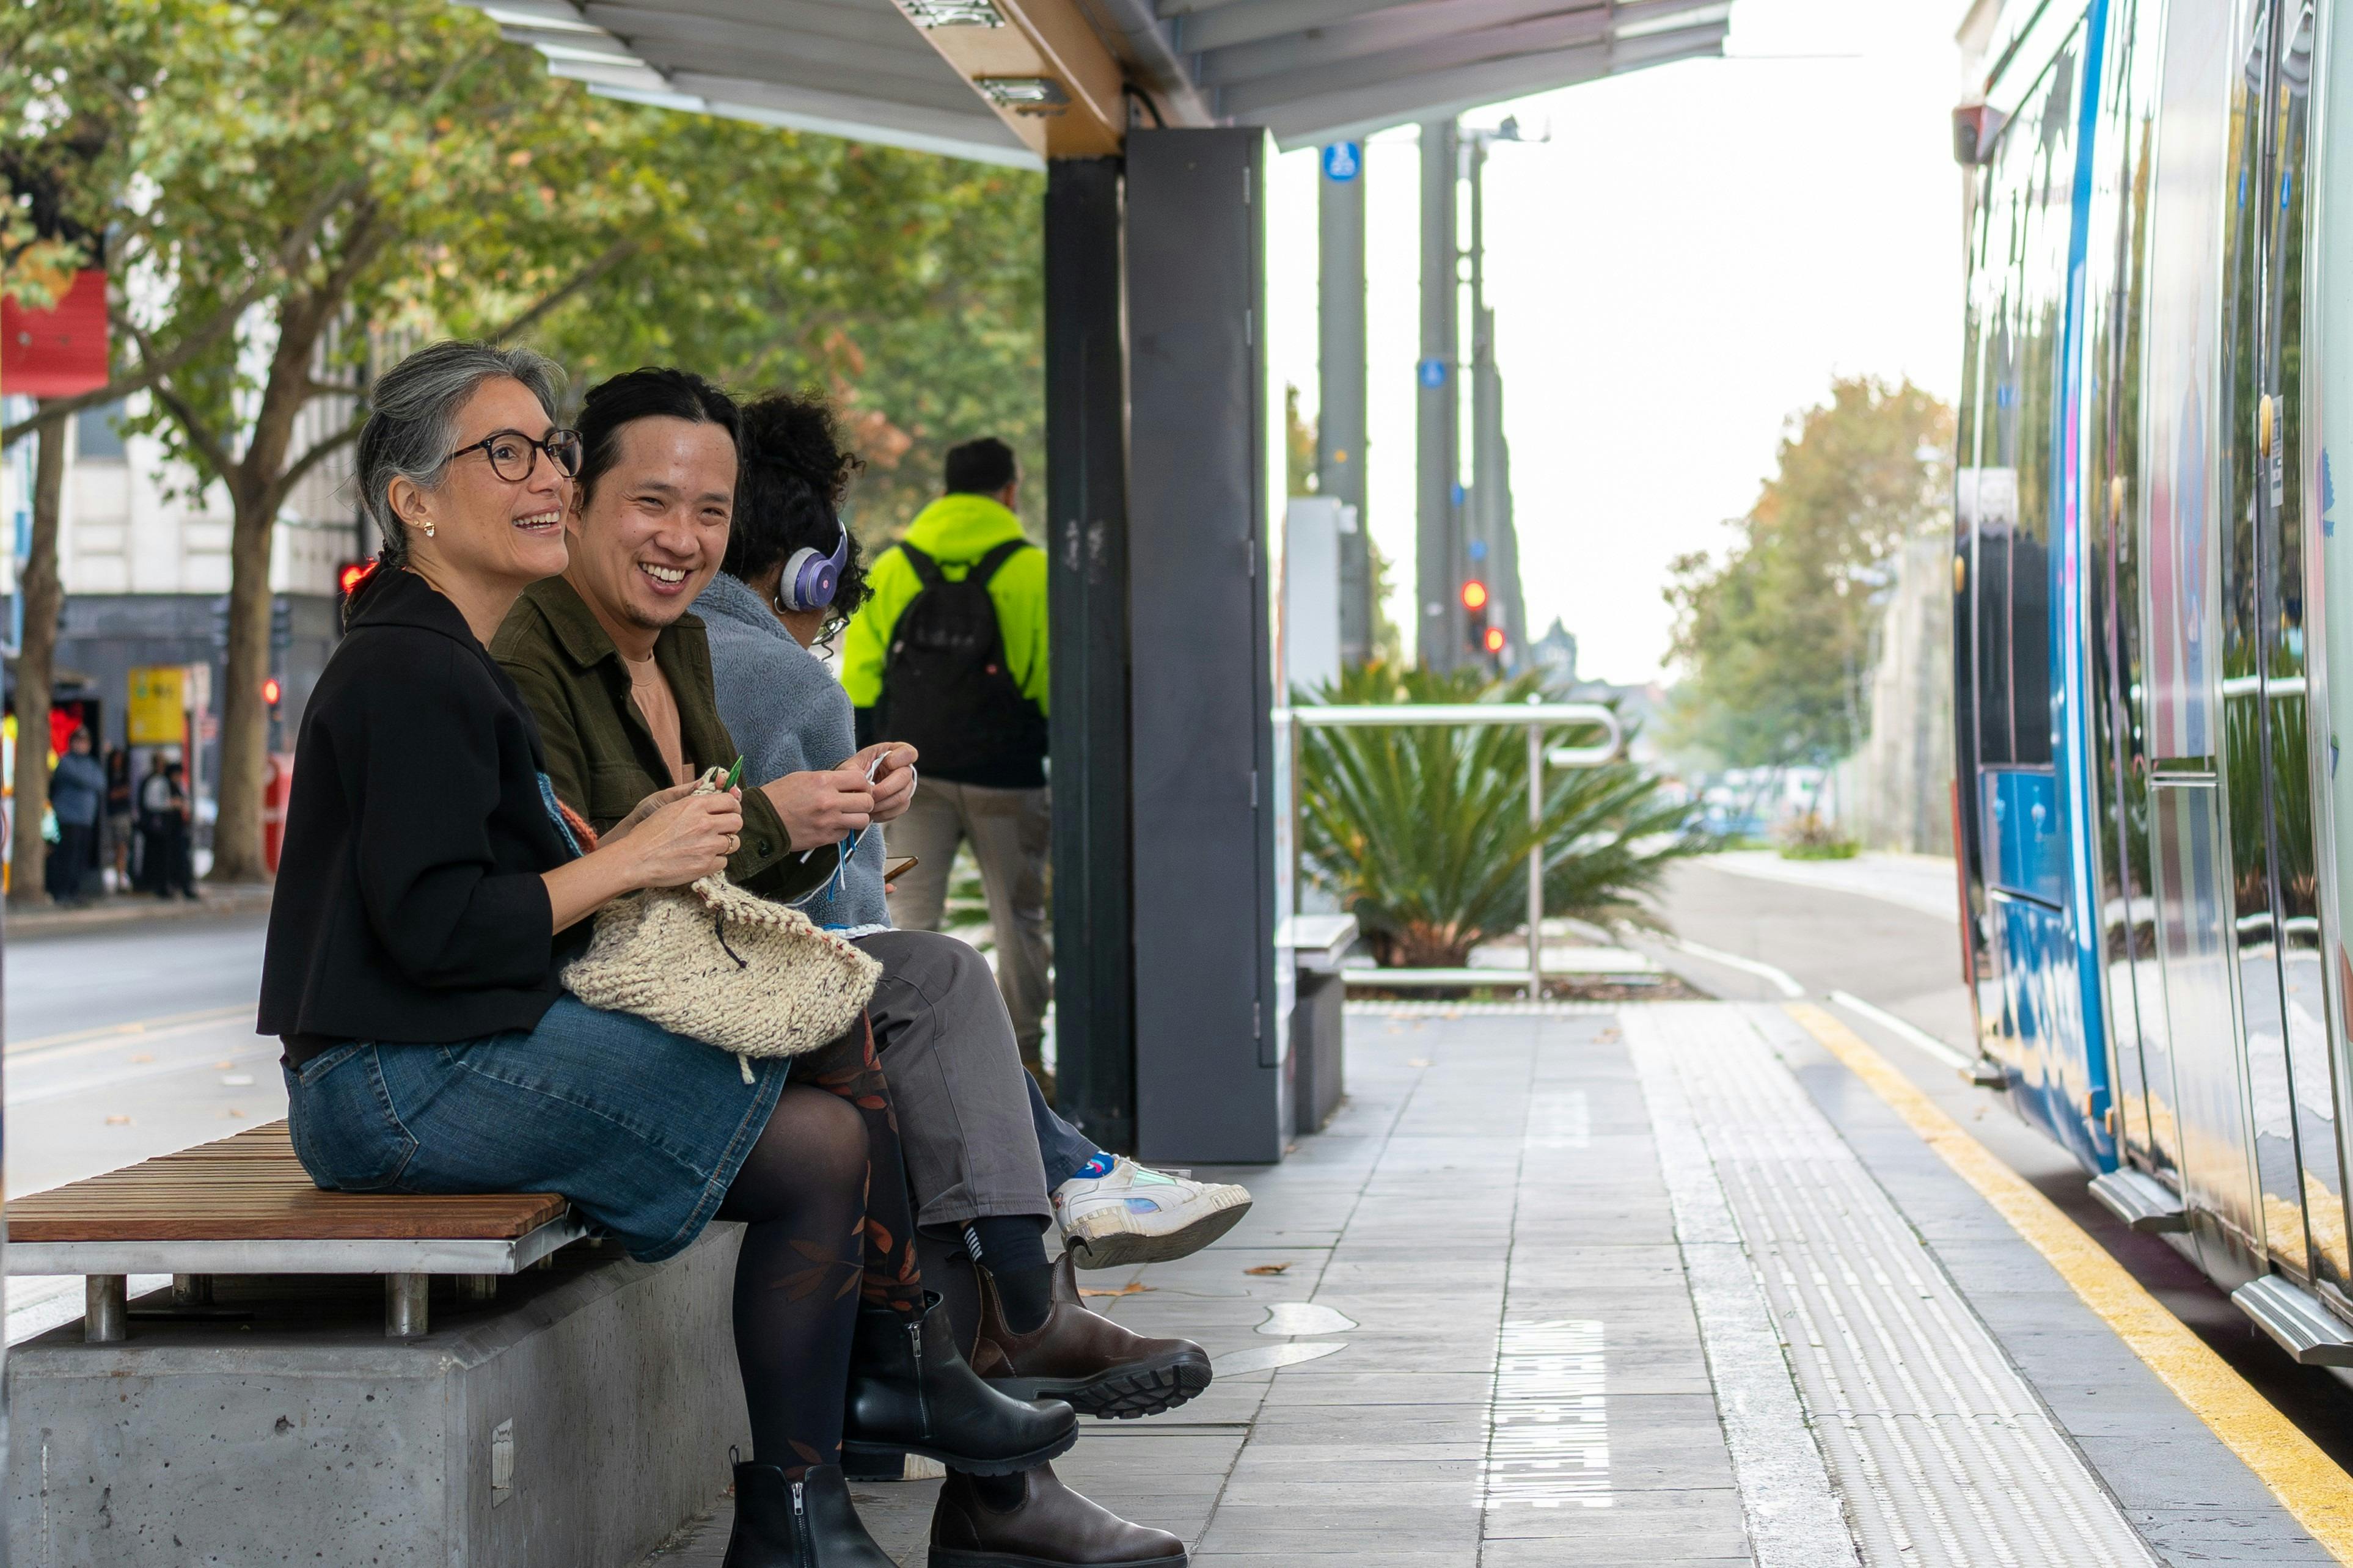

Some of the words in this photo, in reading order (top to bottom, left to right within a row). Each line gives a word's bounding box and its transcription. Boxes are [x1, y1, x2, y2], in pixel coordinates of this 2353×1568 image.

[1495, 1319, 1605, 1354] STAND
[1489, 1355, 1606, 1396] BEHIND
[1483, 1397, 1607, 1423] THE
[1479, 1424, 1609, 1469] WHITE
[1473, 1472, 1612, 1509] LINE
